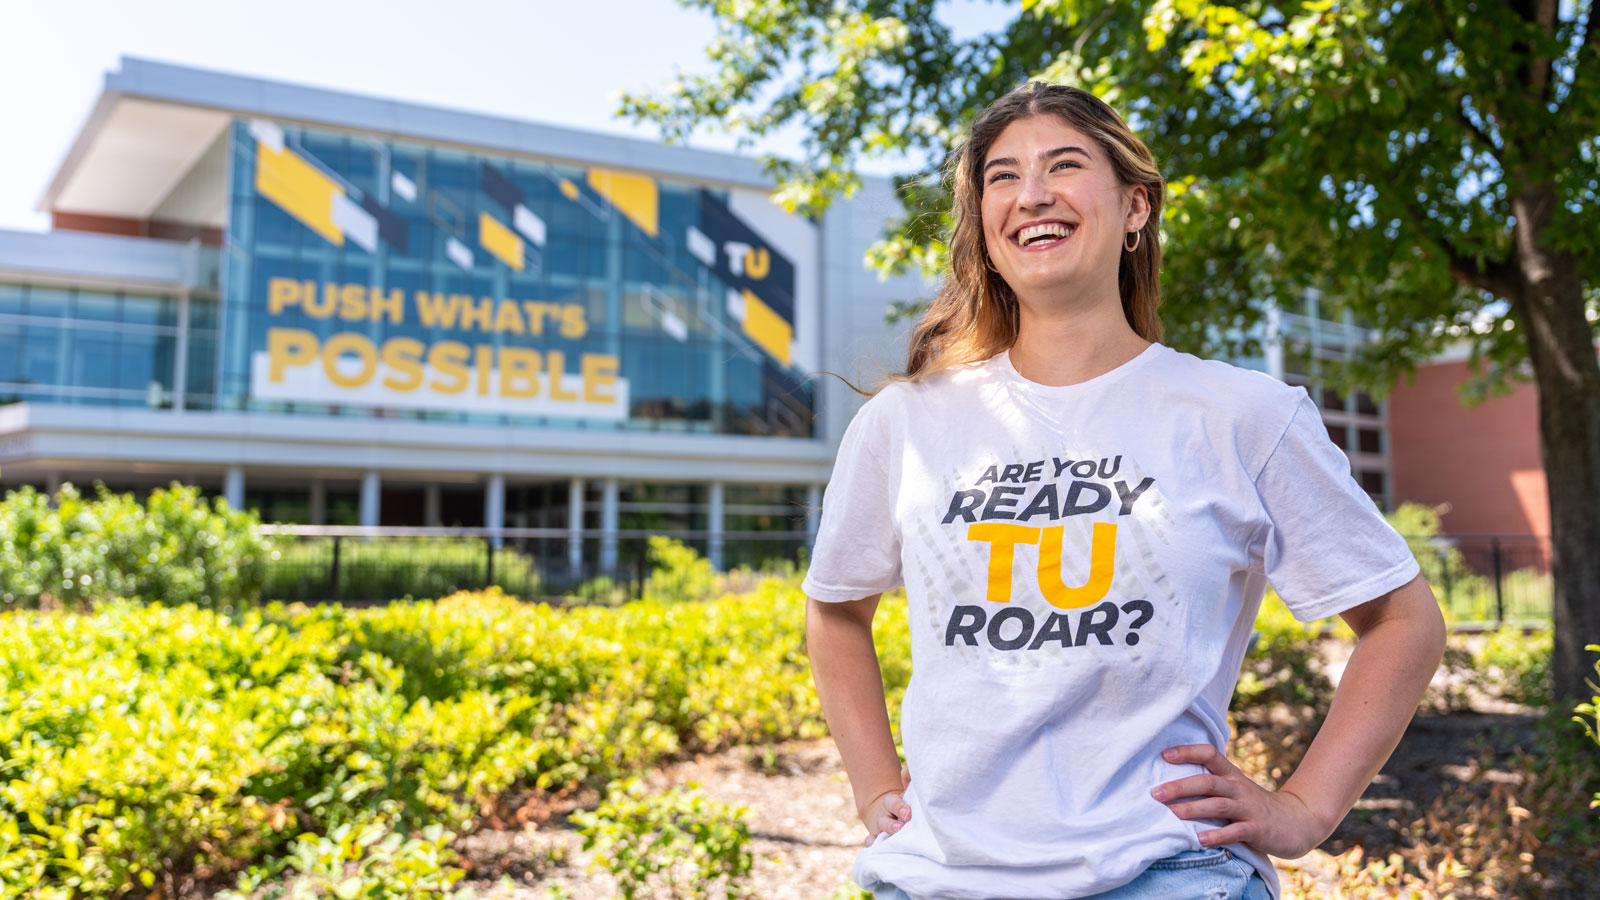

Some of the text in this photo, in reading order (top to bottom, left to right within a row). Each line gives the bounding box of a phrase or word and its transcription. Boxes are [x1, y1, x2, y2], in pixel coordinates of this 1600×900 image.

[724, 241, 771, 280] TU
[267, 277, 588, 339] PUSH WHAT'S
[266, 327, 621, 405] POSSIBLE
[974, 455, 1122, 486] ARE YOU
[941, 477, 1156, 524] READY
[967, 522, 1118, 610] TU
[945, 600, 1154, 651] ROAR?
